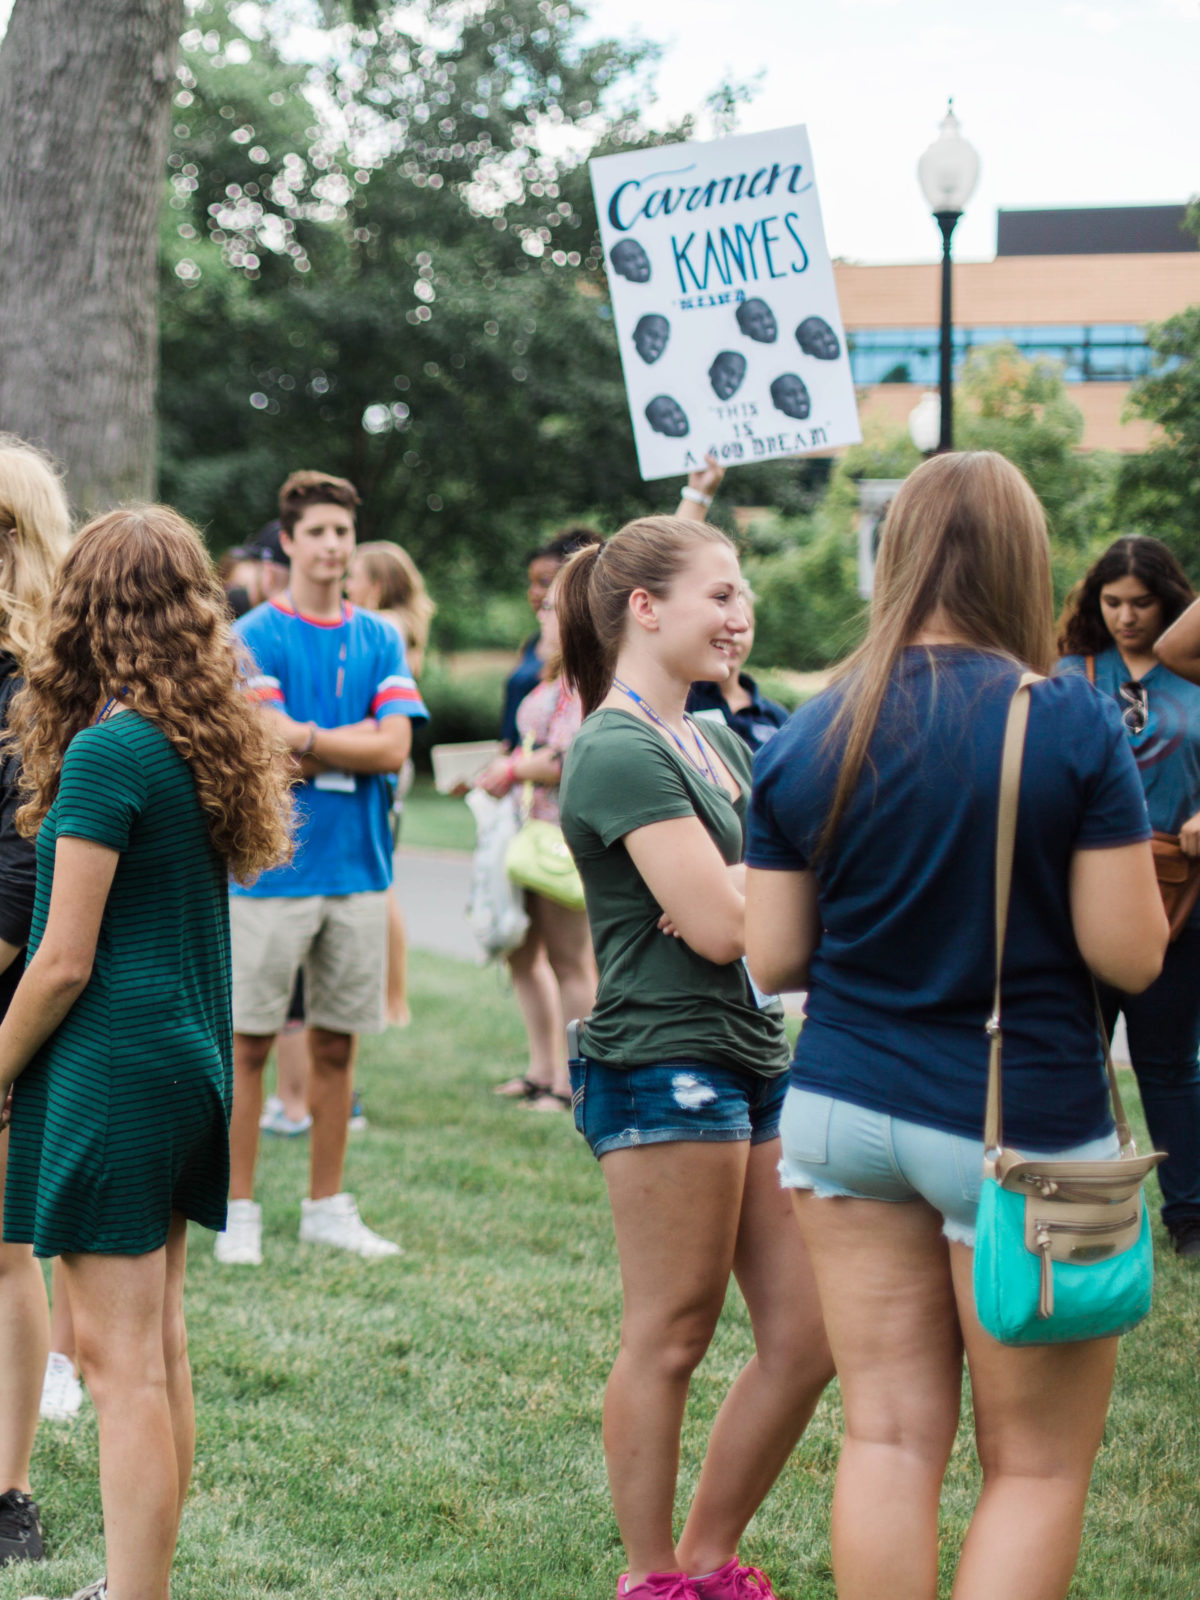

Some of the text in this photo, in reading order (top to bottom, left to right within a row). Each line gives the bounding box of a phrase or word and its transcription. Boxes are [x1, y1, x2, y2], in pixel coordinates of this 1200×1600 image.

[608, 163, 812, 231] Carmen
[671, 212, 809, 294] KANYES
[733, 420, 754, 438] IS
[684, 449, 698, 468] A
